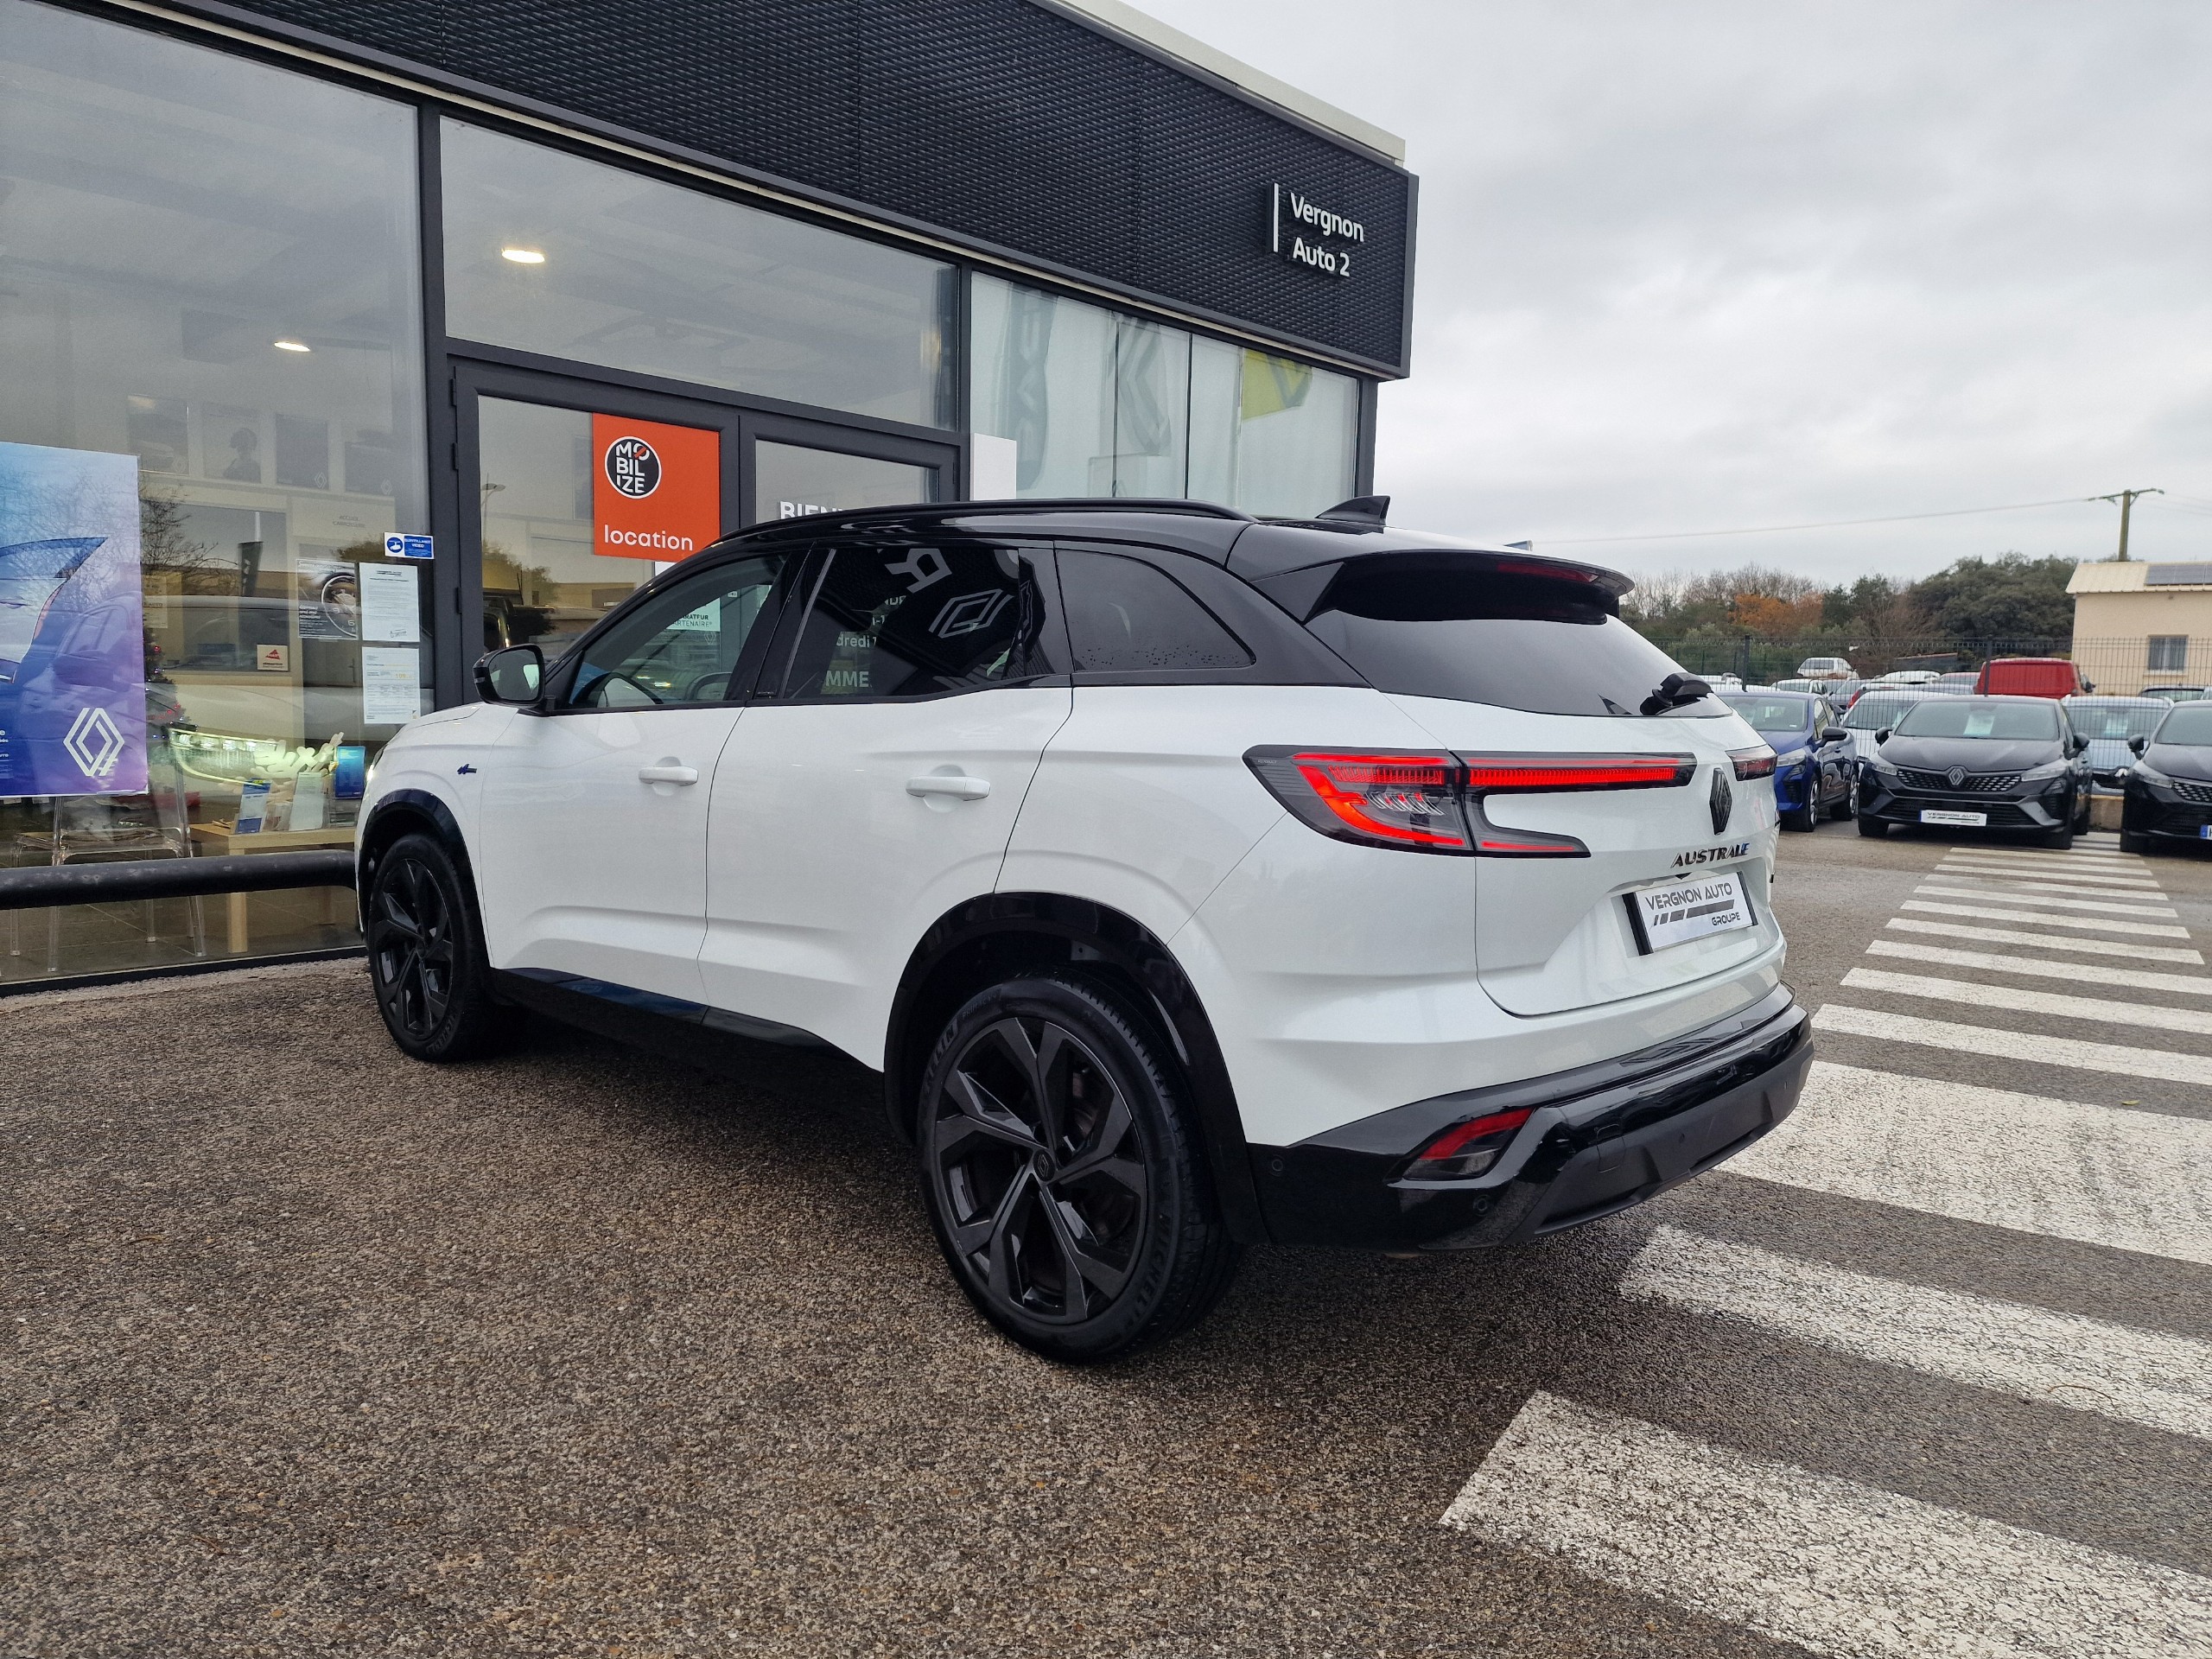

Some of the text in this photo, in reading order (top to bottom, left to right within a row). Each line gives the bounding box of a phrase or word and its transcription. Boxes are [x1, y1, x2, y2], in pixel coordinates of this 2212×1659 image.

[1290, 192, 1364, 242] Vergnon
[1293, 237, 1351, 276] Auto 2
[604, 524, 693, 551] location
[1645, 882, 1732, 911] VERGNON AUTO
[1711, 912, 1741, 926] GROUPE
